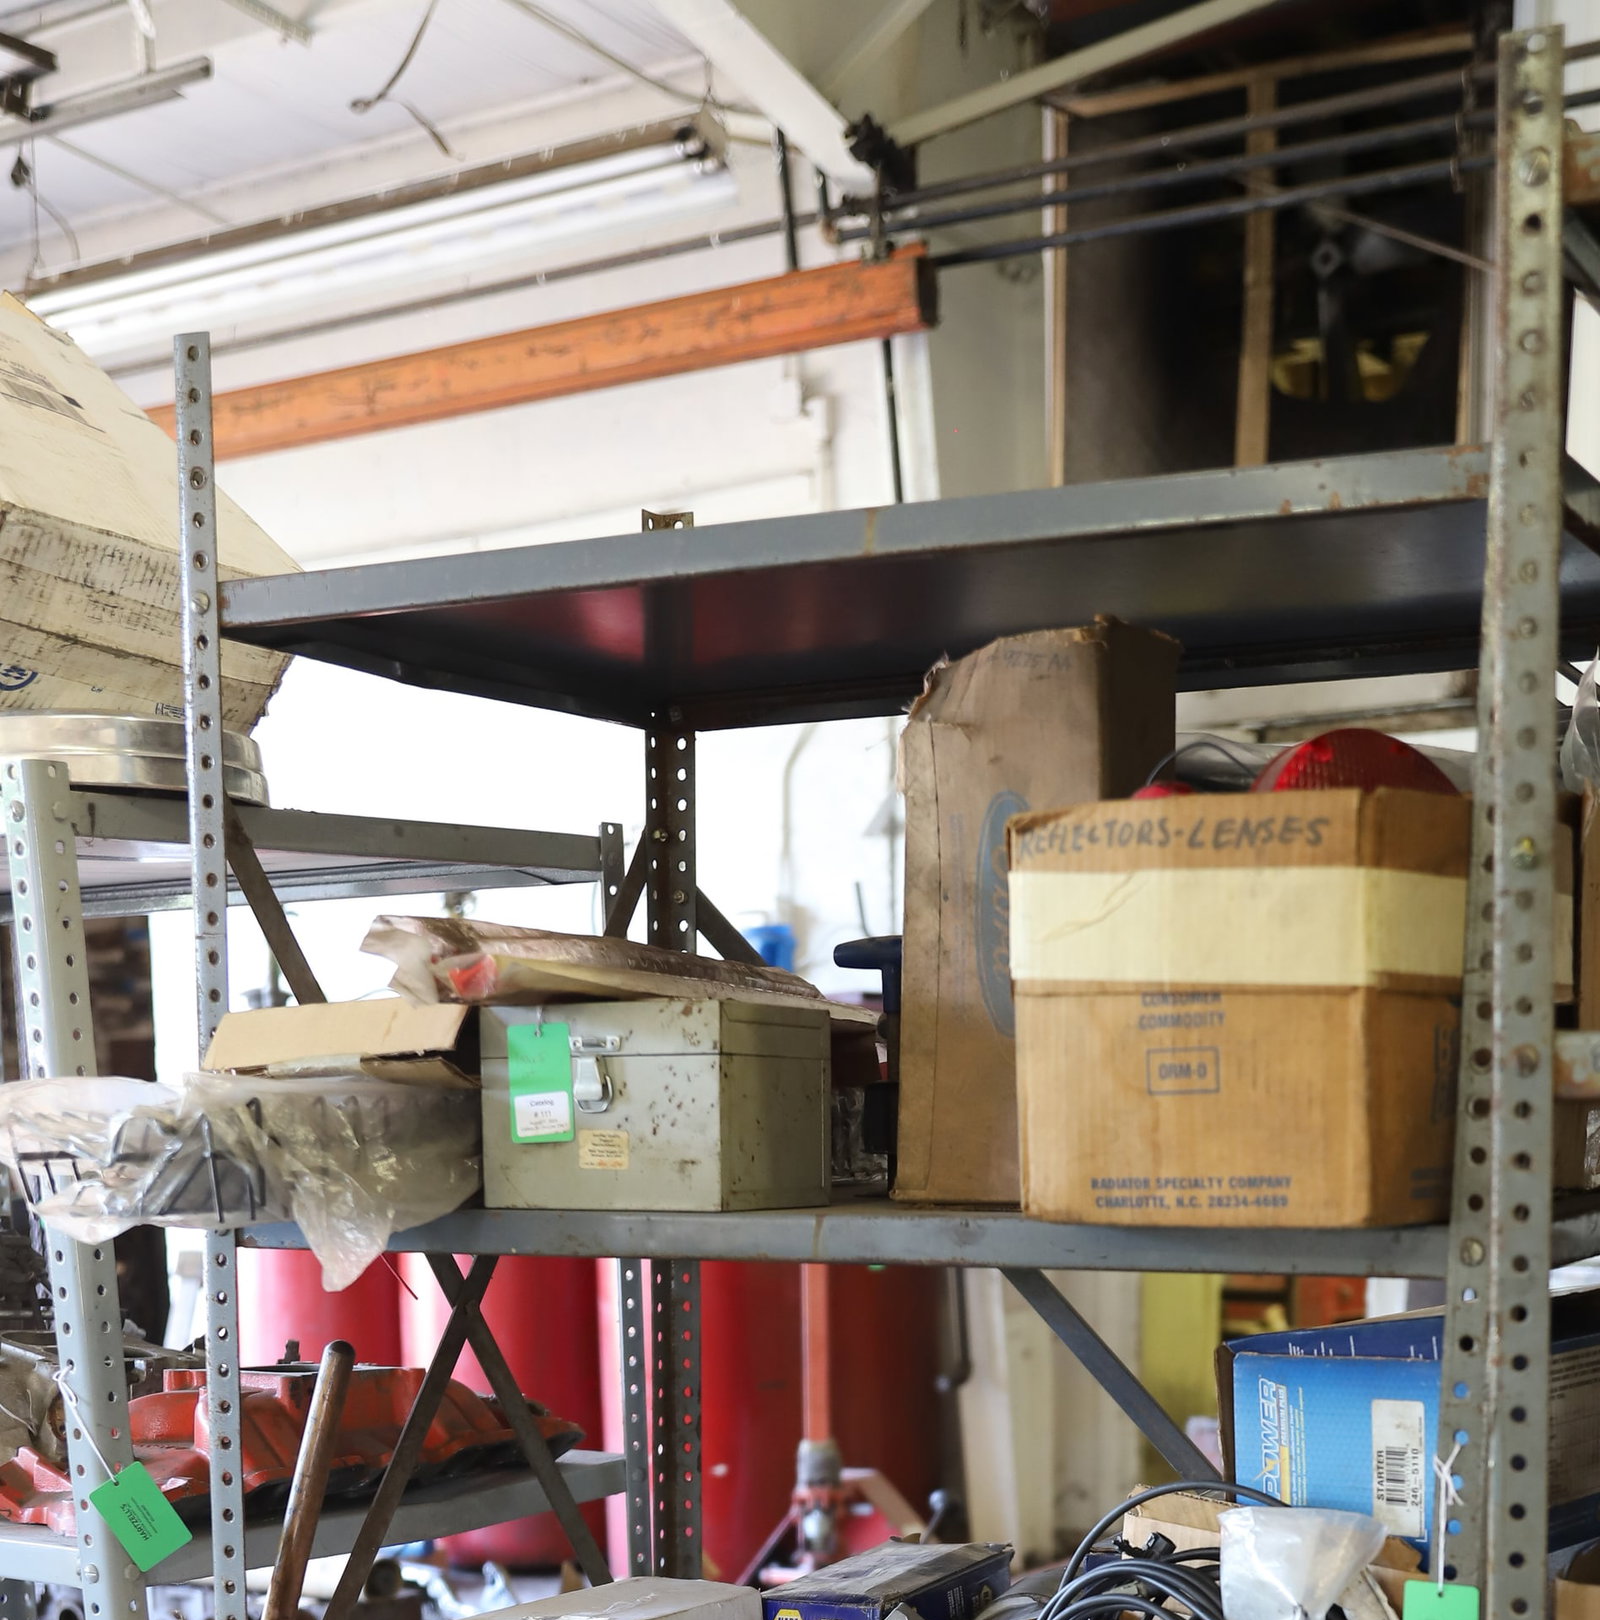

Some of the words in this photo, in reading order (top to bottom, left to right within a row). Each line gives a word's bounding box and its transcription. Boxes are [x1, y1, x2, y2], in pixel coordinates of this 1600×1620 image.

[1138, 1010, 1226, 1031] COMMODITY
[1158, 1061, 1207, 1079] ORM-D
[1090, 1177, 1151, 1190] RADIATOR
[1155, 1176, 1223, 1190] SPECIALTY
[1228, 1176, 1291, 1189] COMPANY
[1176, 1195, 1202, 1208] N.C.
[1259, 1377, 1281, 1499] POWER
[1376, 1449, 1385, 1501] STARTER
[119, 1503, 150, 1541] HARTZELL'S
